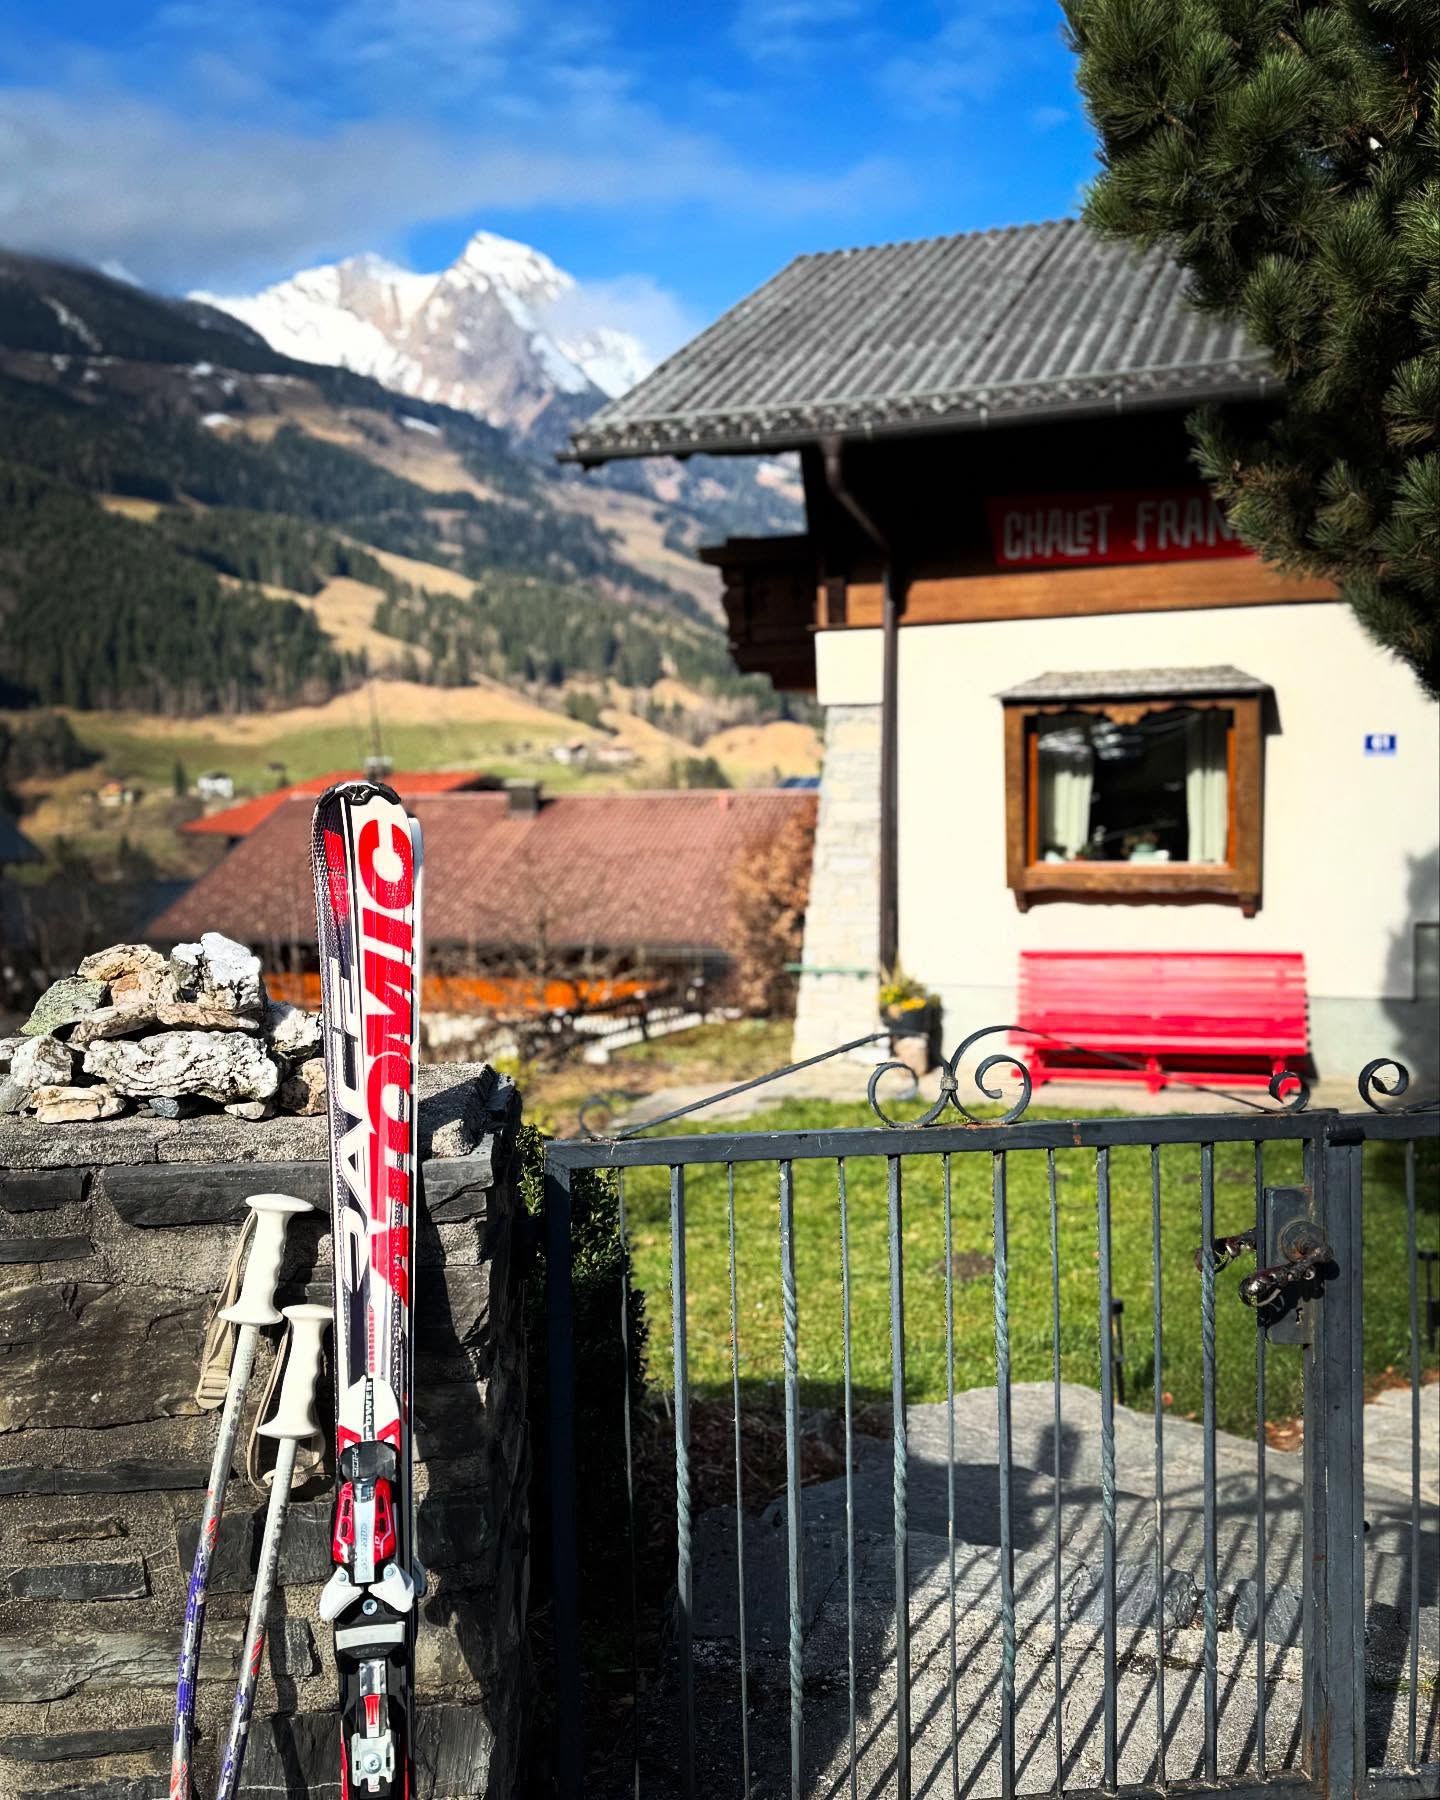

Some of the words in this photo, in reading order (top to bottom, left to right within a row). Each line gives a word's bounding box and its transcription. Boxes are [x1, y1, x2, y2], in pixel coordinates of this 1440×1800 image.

[1003, 504, 1113, 561] CHALET
[1135, 497, 1237, 552] FRAN
[329, 956, 368, 1293] RACE
[358, 819, 412, 1308] ATOMIC
